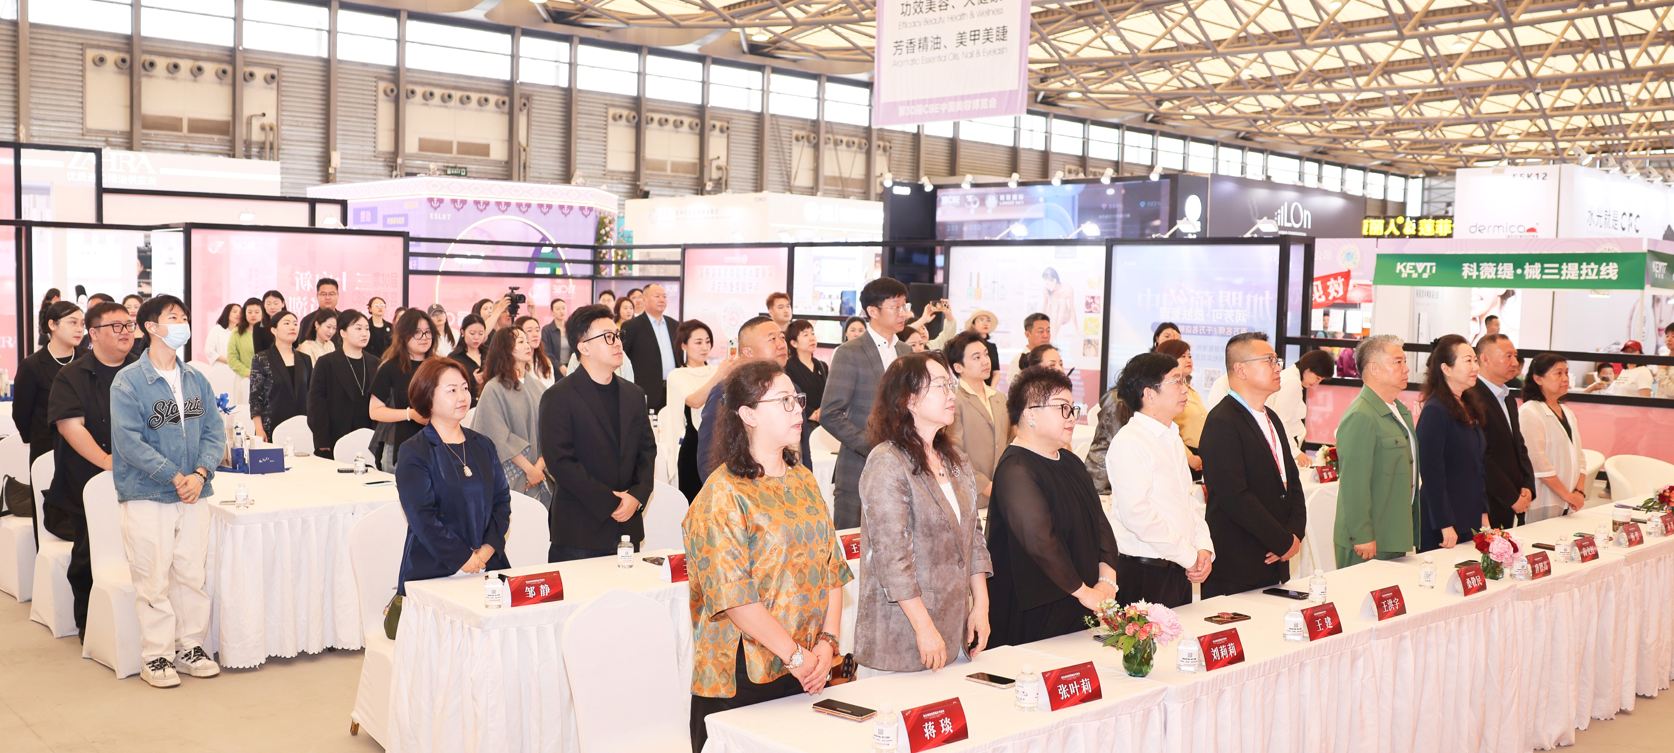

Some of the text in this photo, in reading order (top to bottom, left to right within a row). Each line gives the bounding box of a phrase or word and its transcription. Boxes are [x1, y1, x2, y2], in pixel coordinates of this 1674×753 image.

[898, 19, 922, 30] Efficacy
[947, 12, 969, 22] Health
[976, 7, 1005, 18] Wellness
[893, 25, 1008, 56] 芳香精油、美甲美睫
[892, 56, 920, 68] Aromatic
[921, 53, 947, 64] Essential
[961, 49, 974, 59] Nail
[982, 47, 1008, 58] Eyelash
[1469, 222, 1526, 234] dermica
[1462, 261, 1619, 280] 科薇缇·械三提拉线
[524, 583, 550, 599] 邹静
[1316, 617, 1334, 633] 王建
[1211, 643, 1237, 662] 刘莉莉
[1057, 677, 1093, 701] 张叶莉
[922, 717, 953, 740] 蒋琰
